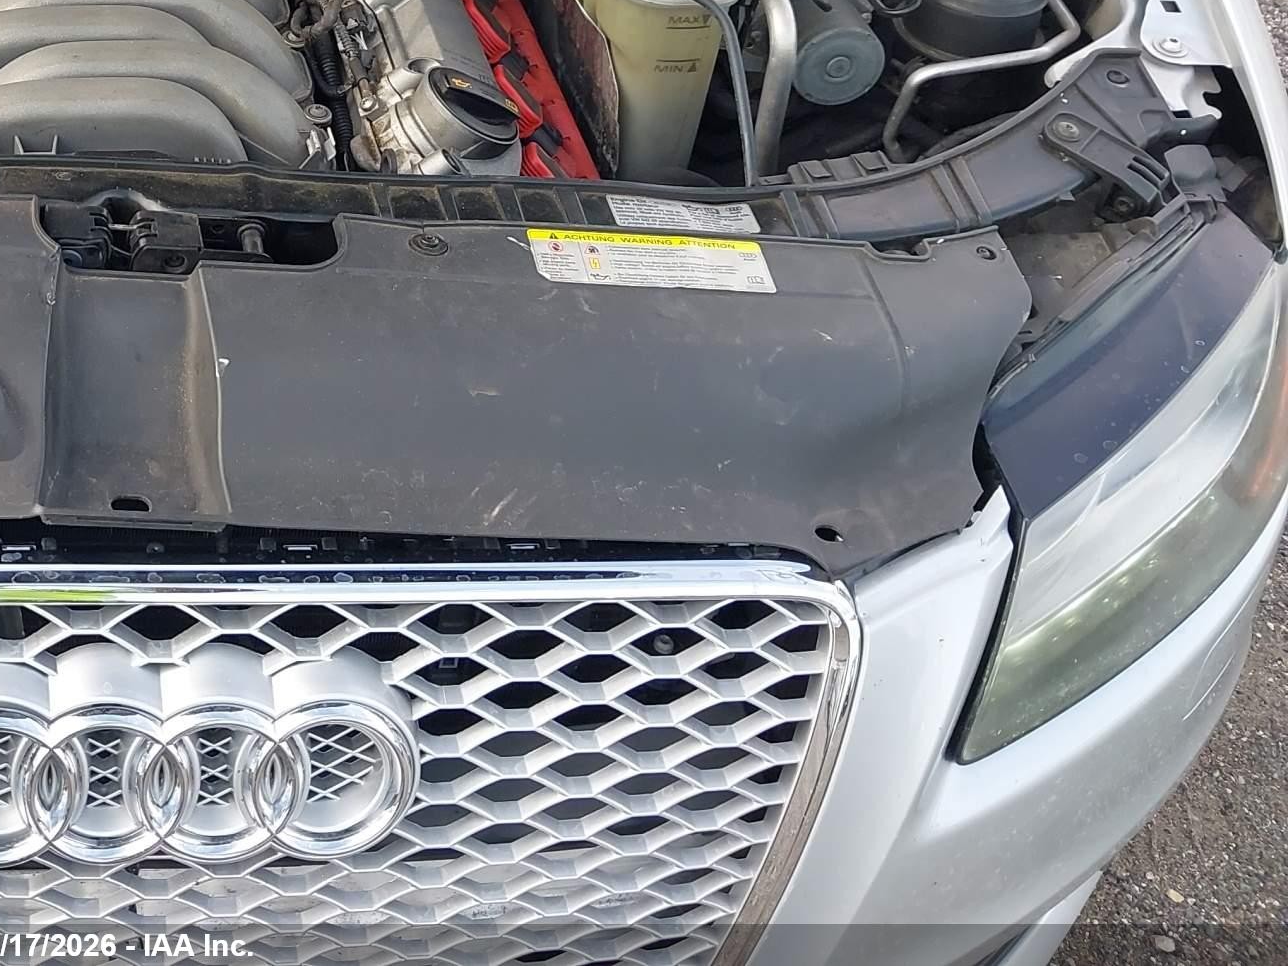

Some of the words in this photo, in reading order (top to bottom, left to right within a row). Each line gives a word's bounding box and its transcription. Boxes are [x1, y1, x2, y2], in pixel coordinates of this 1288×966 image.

[667, 15, 700, 25] MAX
[654, 64, 684, 73] MIN
[563, 234, 615, 243] ACHTUNG
[619, 236, 673, 246] WARNING
[678, 239, 736, 250] ATTENTION
